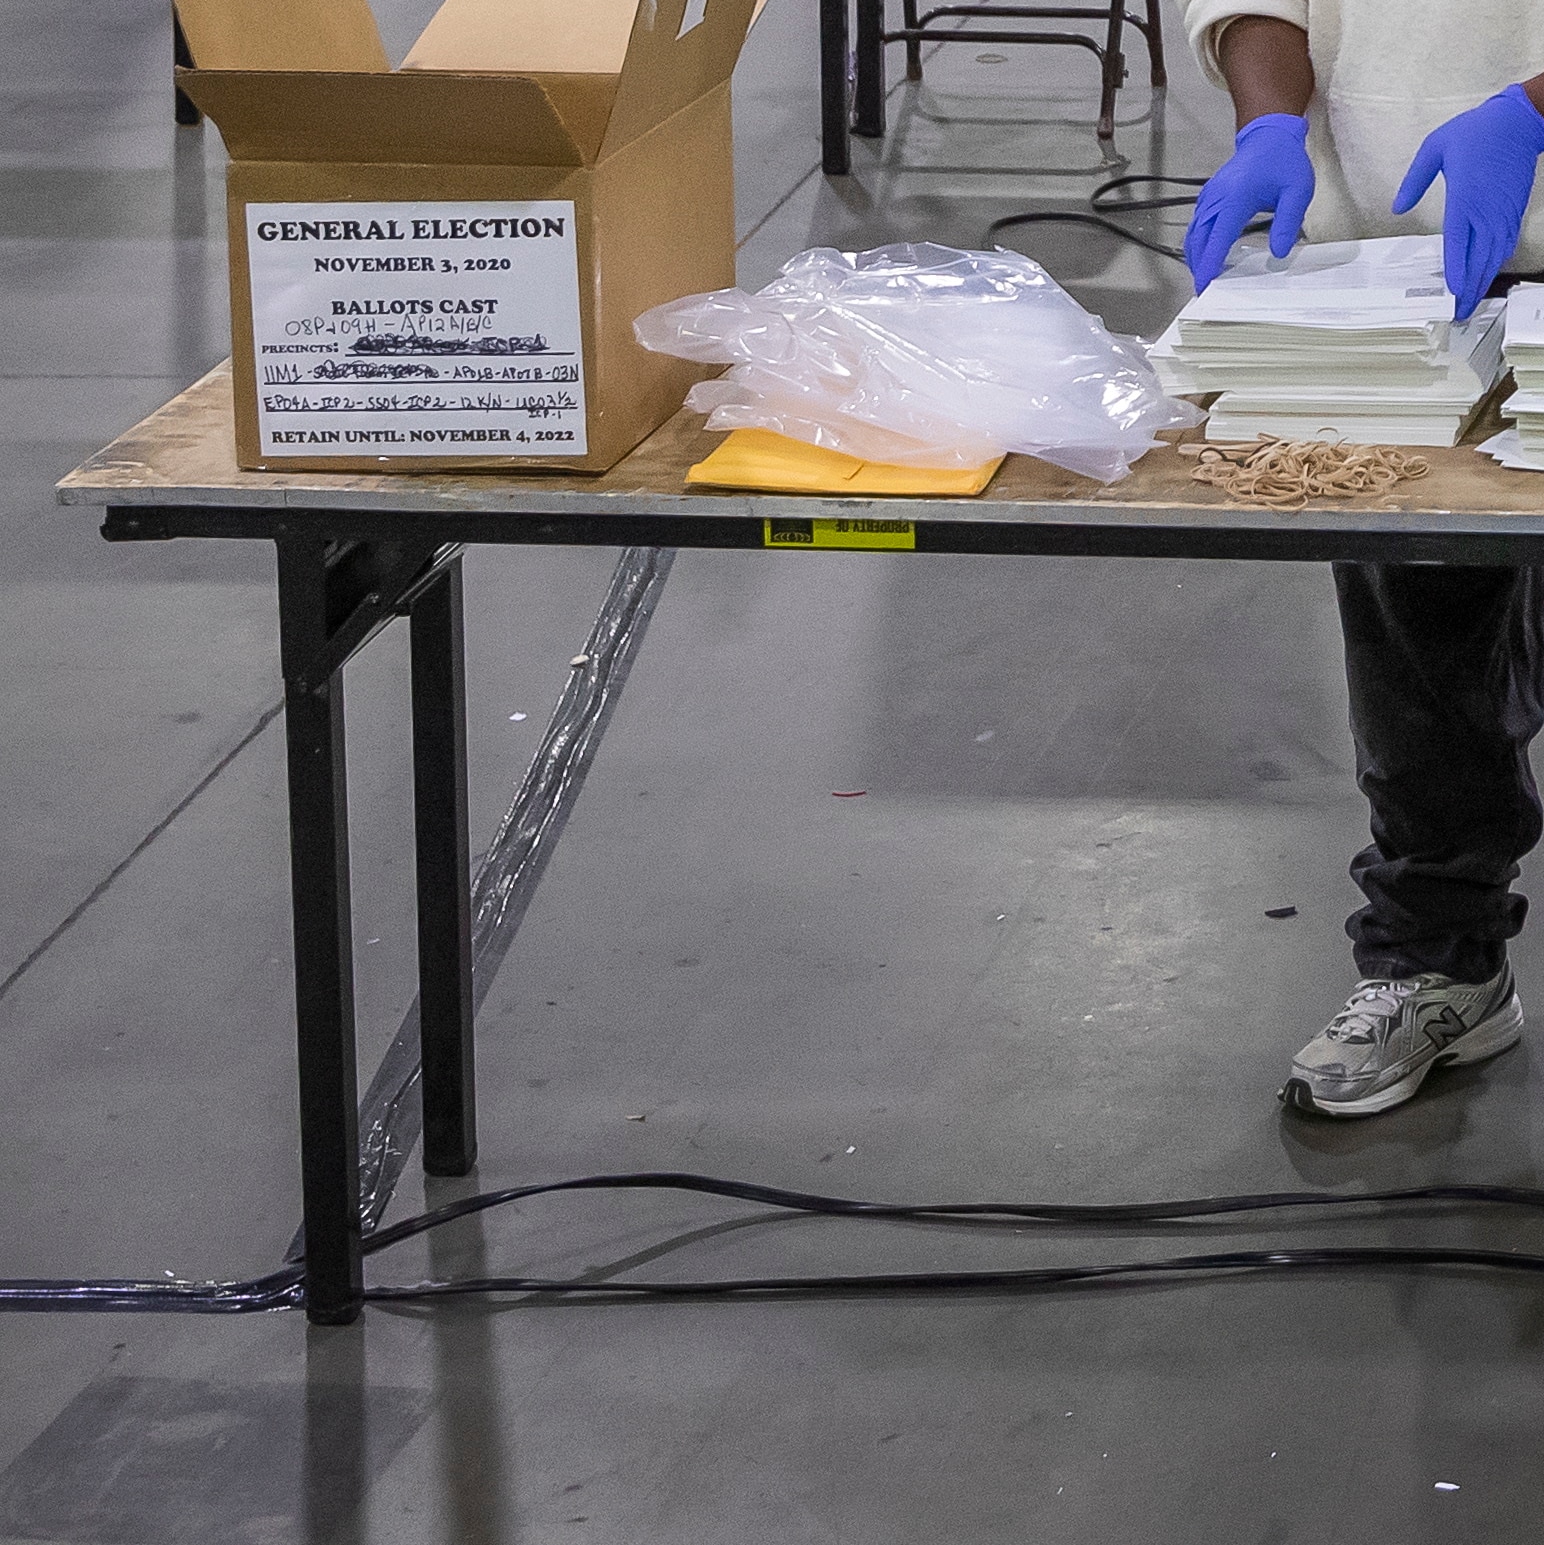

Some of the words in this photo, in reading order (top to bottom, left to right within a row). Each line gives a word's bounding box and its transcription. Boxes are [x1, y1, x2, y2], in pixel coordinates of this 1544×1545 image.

[257, 219, 404, 242] GENERAL
[411, 217, 566, 241] ELECTION
[314, 257, 436, 272] NOVEMBER
[440, 258, 458, 275] 3,
[463, 258, 511, 272] 2020
[331, 299, 433, 315] BALLOTS
[438, 299, 499, 314] CAST
[262, 342, 339, 354] PRECINCTS:
[271, 430, 341, 443] RETAIN
[345, 430, 405, 442] UNTIL:
[410, 429, 511, 442] NOVEMBER
[516, 429, 531, 444] 4,
[535, 429, 575, 442] 2022
[836, 519, 849, 533] OF
[852, 519, 910, 533] PROPERTY
